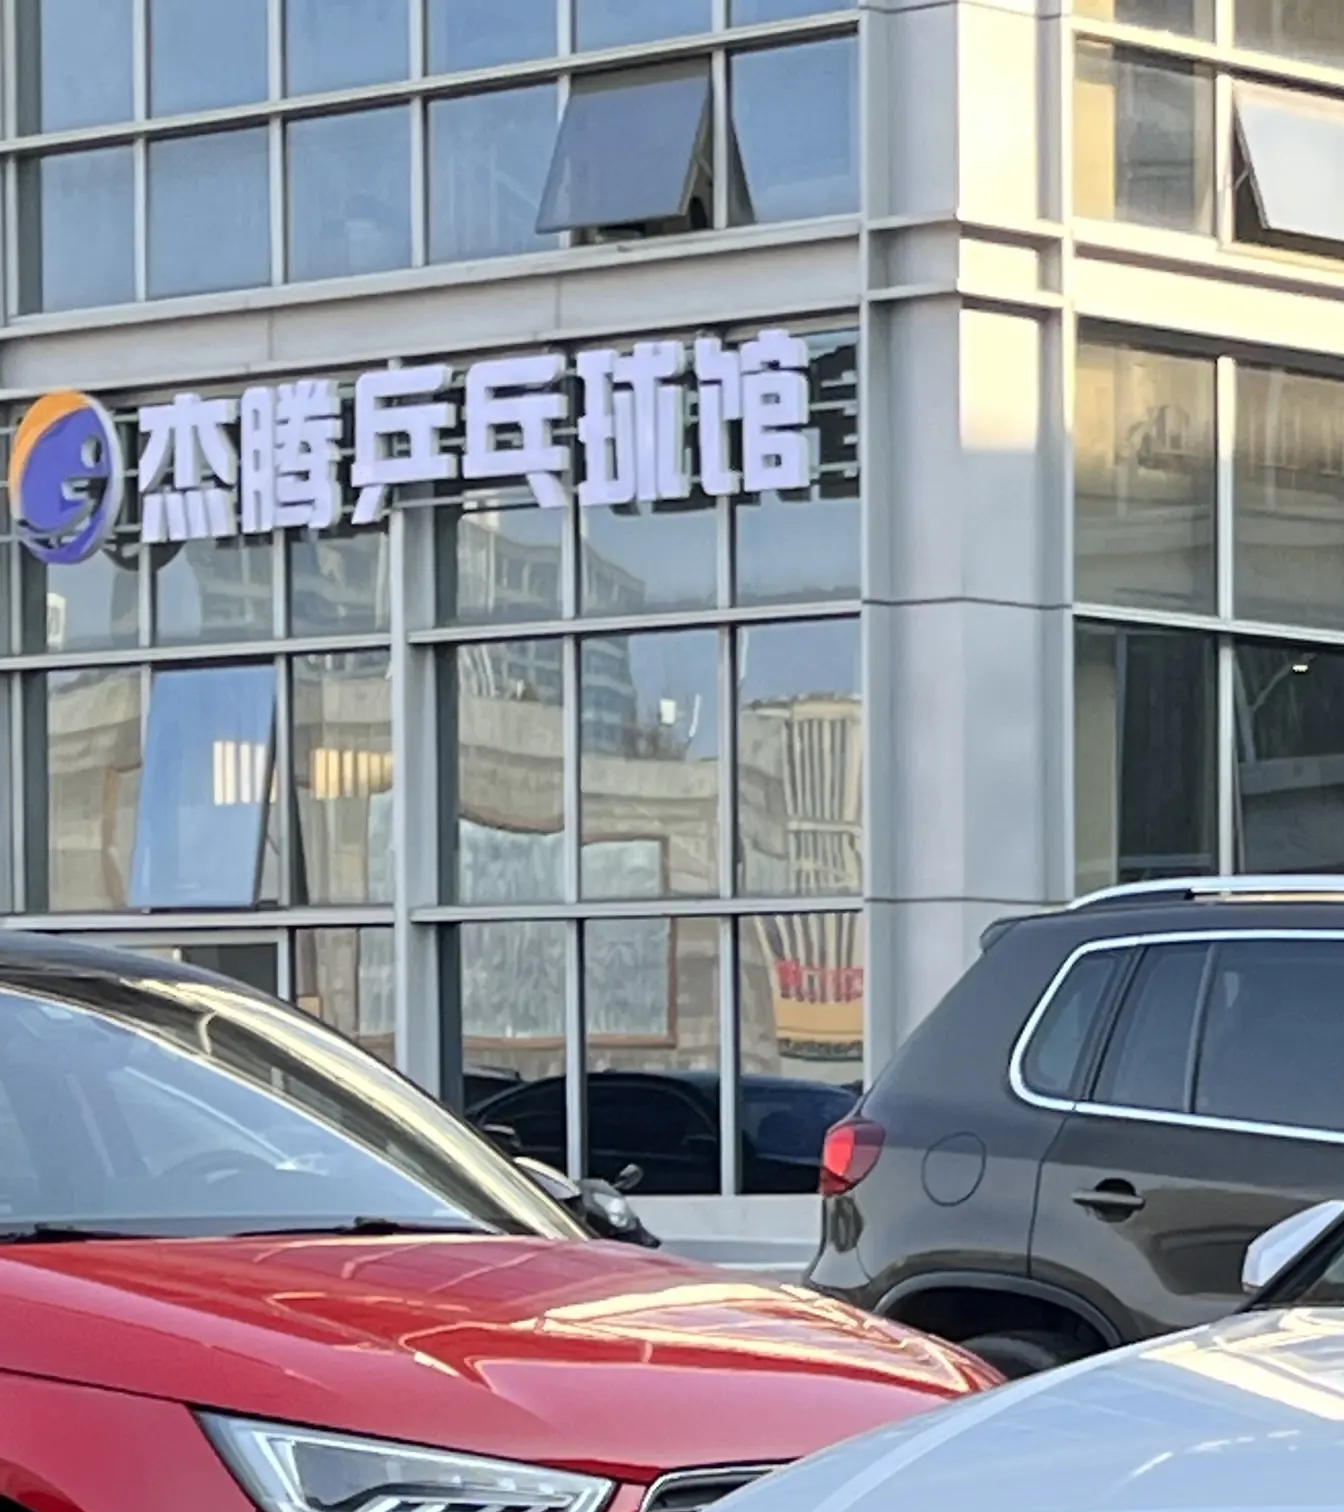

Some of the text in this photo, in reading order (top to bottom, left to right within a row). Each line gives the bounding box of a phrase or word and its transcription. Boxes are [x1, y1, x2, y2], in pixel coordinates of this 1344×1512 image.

[138, 328, 812, 544] 杰腾乒乓球馆
